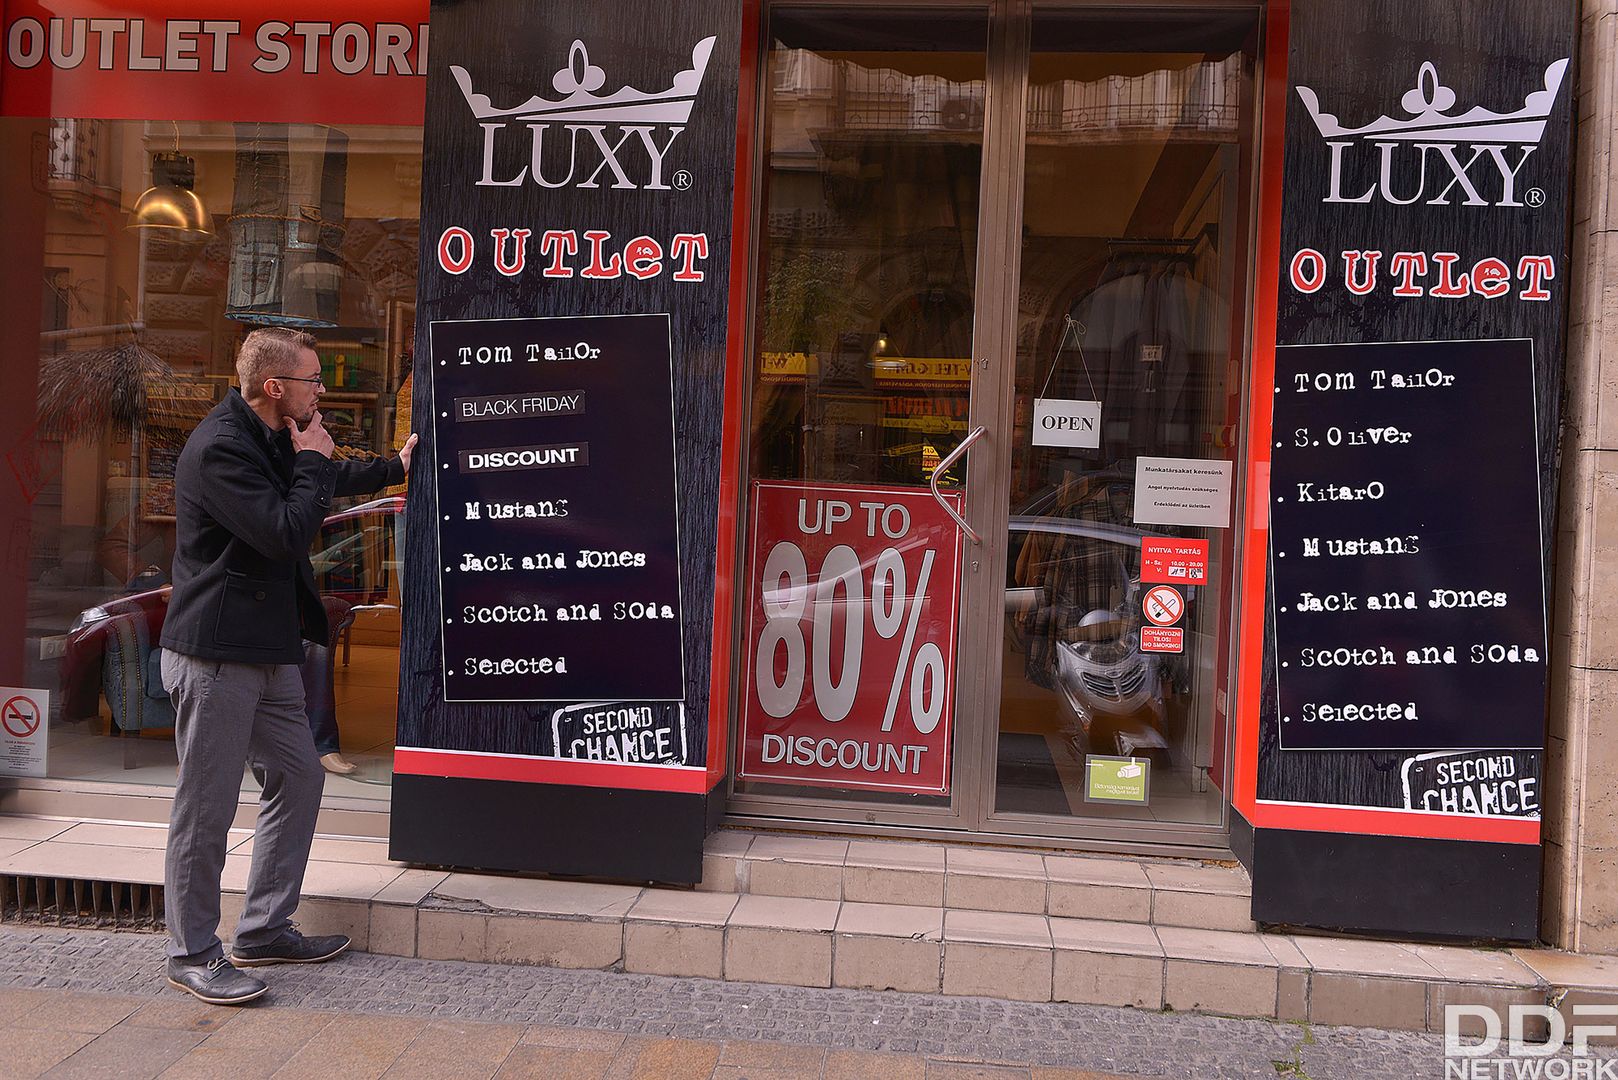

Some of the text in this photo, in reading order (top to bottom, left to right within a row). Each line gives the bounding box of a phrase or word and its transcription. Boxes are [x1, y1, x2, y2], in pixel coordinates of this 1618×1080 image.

[7, 16, 241, 73] OUTLET
[475, 122, 686, 191] LUXY
[1322, 141, 1538, 207] LUXY
[462, 394, 580, 417] BLACK FRIDAY
[1041, 415, 1094, 431] OPEN
[468, 448, 579, 469] DISCOUNT
[465, 499, 568, 521] Mustang
[798, 498, 911, 539] UP TO
[1175, 547, 1201, 555] TARTÁS
[1303, 535, 1419, 557] Mustang
[460, 553, 514, 573] Jack
[521, 552, 567, 571] and
[556, 602, 602, 622] and
[1297, 592, 1358, 613] Jack
[1367, 591, 1418, 611] and
[756, 541, 945, 734] 80%
[464, 656, 568, 676] Selected
[1406, 645, 1458, 665] and
[583, 706, 653, 734] SECOND
[1302, 702, 1419, 723] Selected
[568, 727, 674, 763] CHANCE
[761, 733, 929, 774] DISCOUNT
[1437, 755, 1516, 785] SECOND
[1423, 777, 1539, 815] CHANCE
